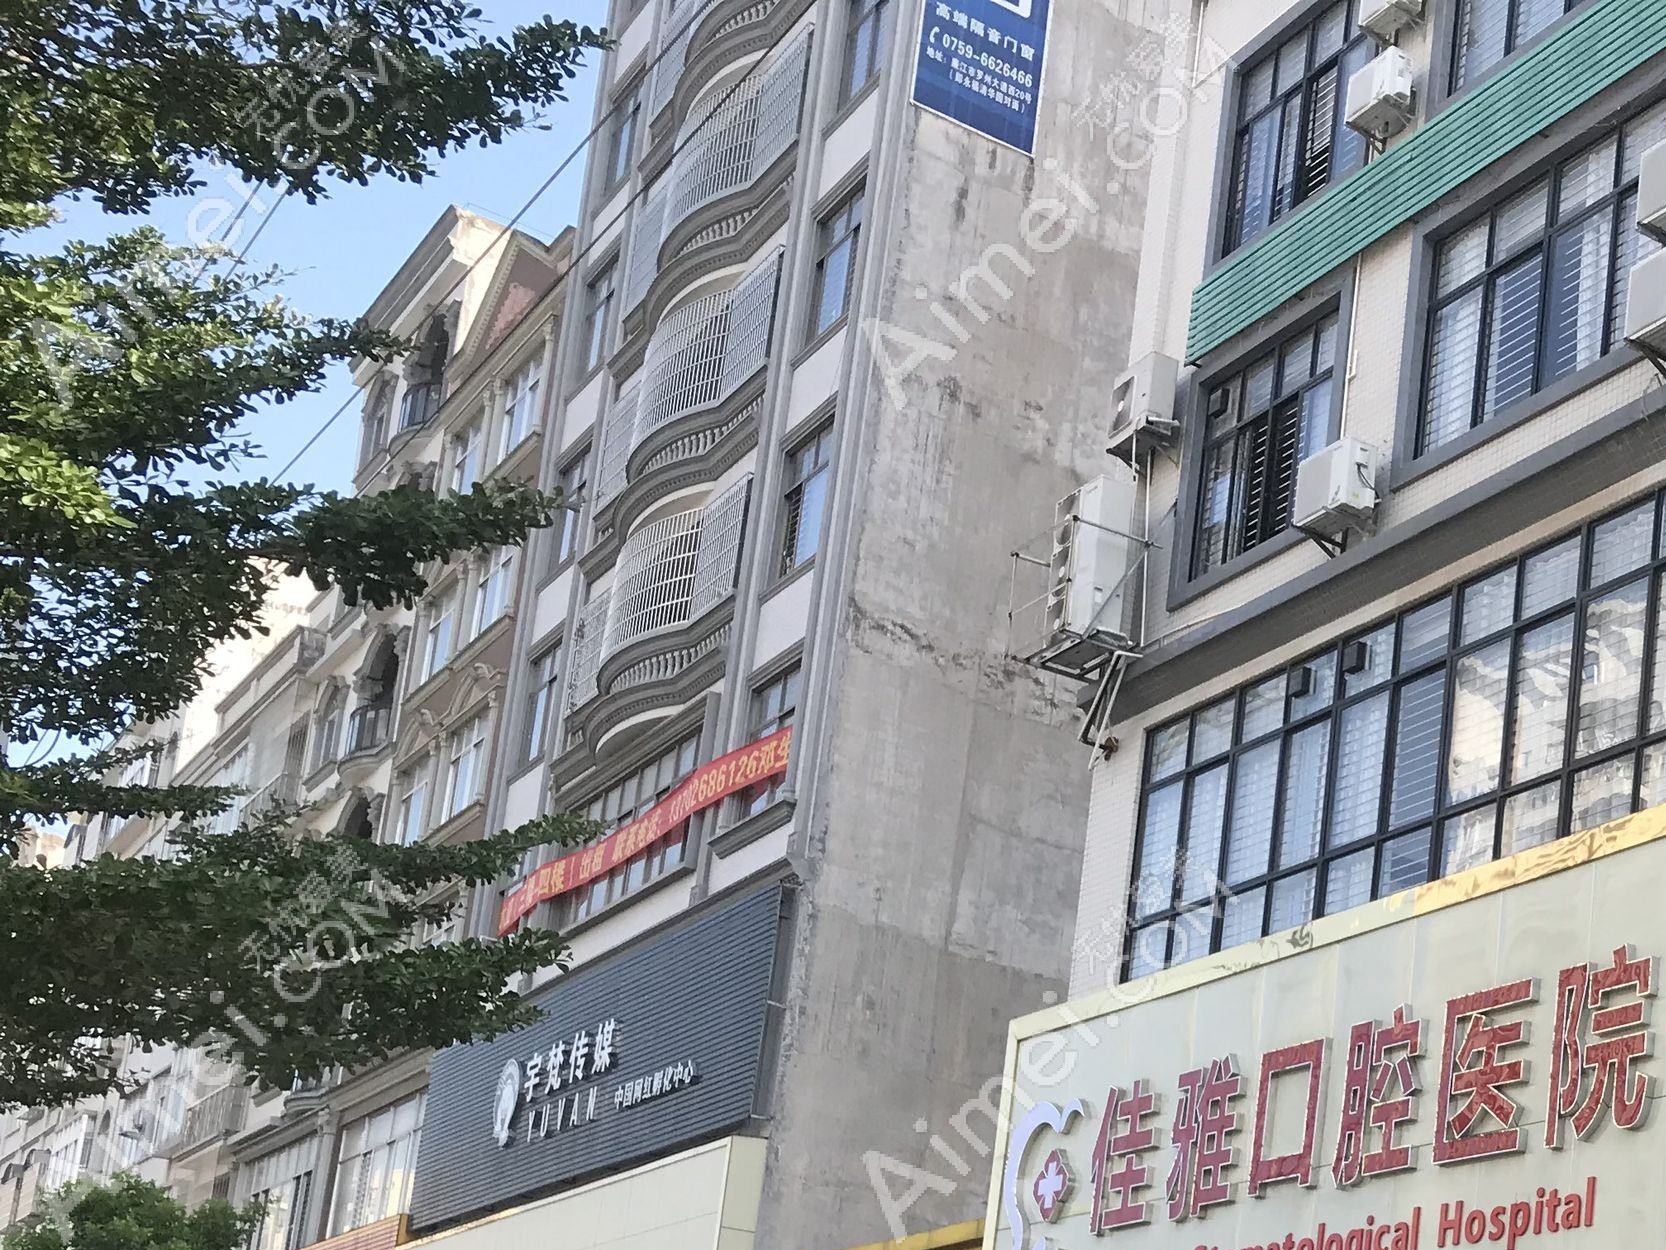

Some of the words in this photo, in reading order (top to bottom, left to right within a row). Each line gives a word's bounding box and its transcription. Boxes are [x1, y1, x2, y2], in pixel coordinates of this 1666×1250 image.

[935, 2, 1035, 61] 高端隔音门窗
[942, 34, 1033, 88] 0759-6626466
[579, 841, 608, 880] 出租
[524, 1018, 615, 1103] 宇梵传媒
[614, 1059, 694, 1111] 中国网红孵化中心
